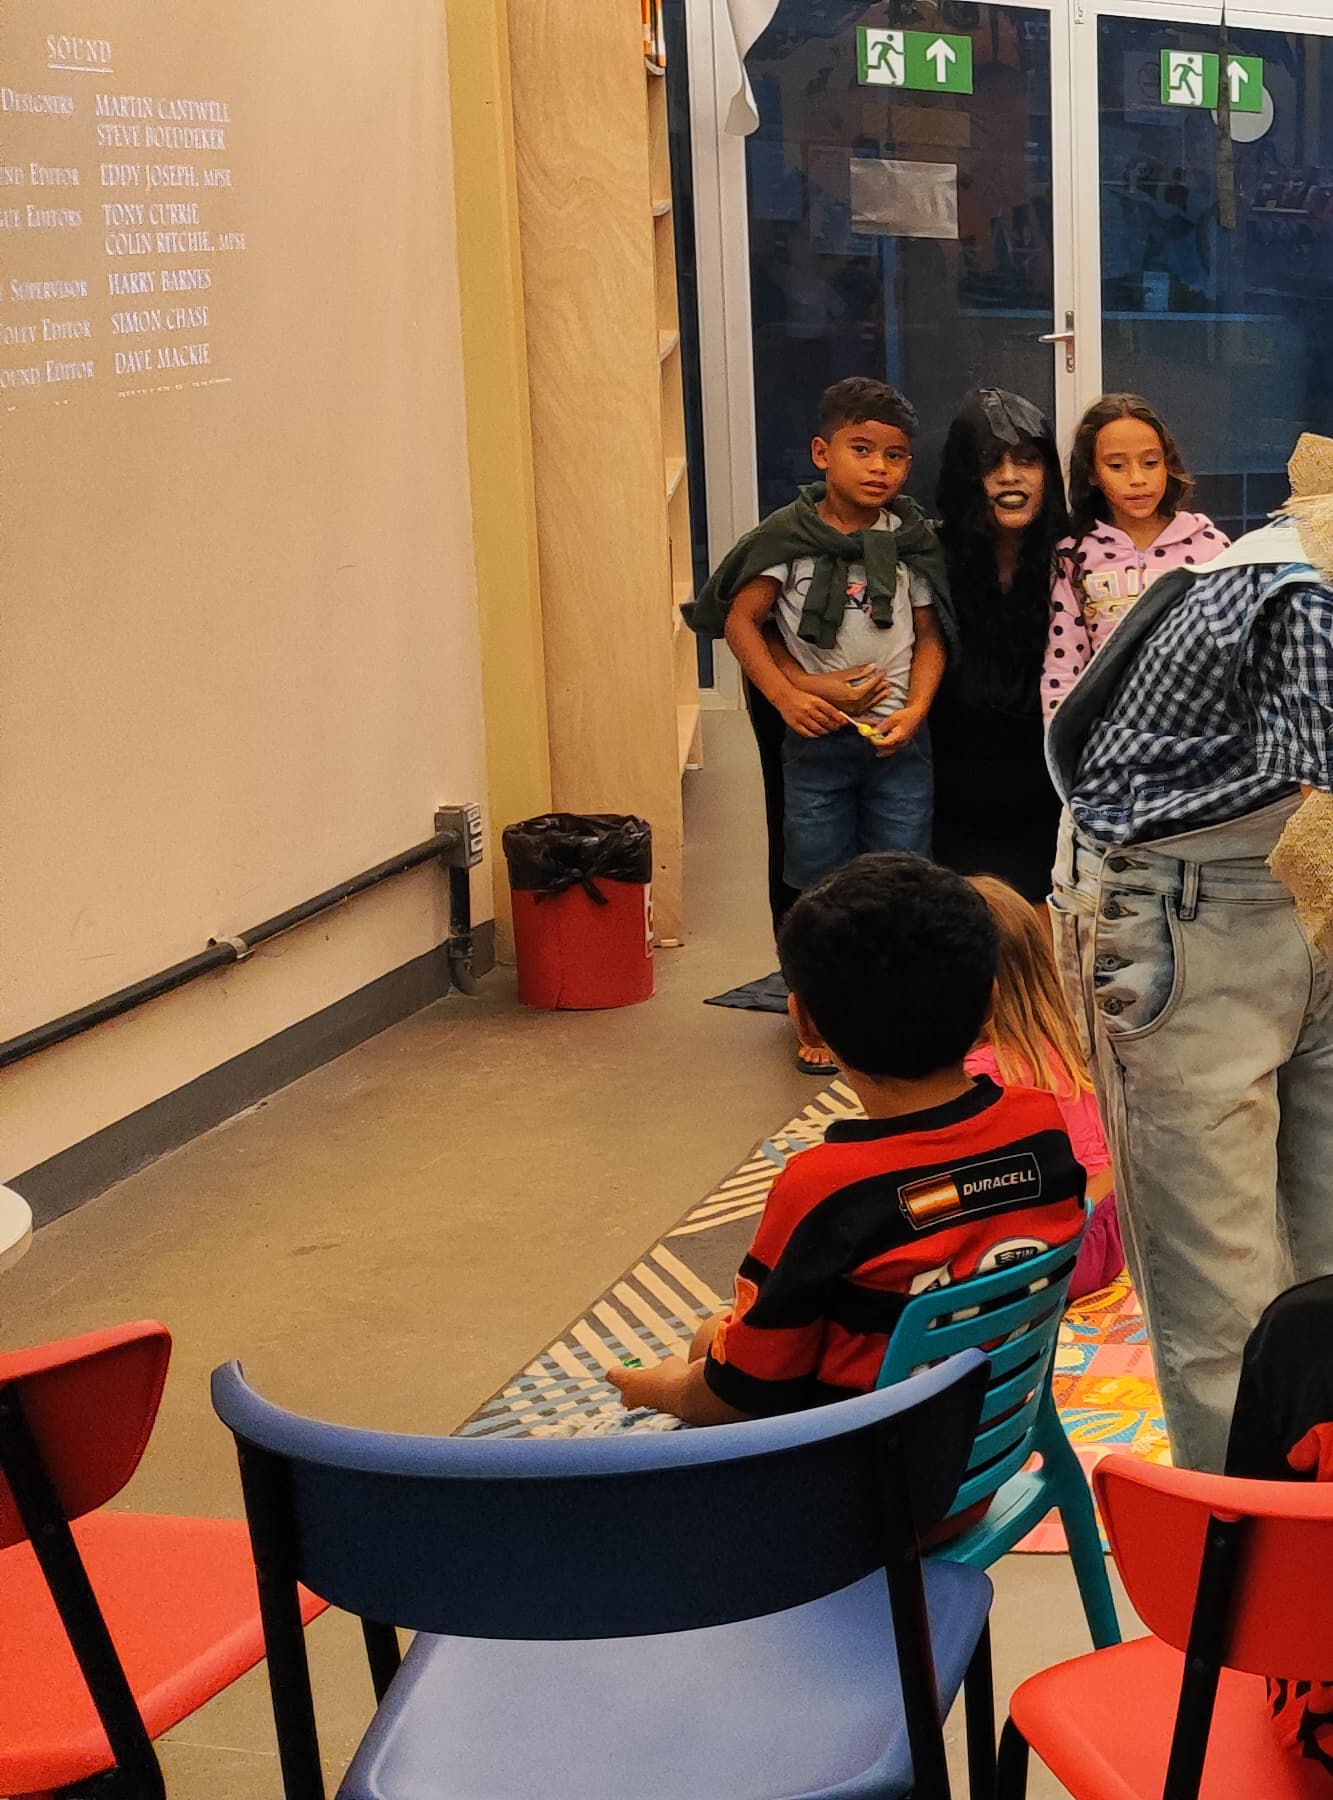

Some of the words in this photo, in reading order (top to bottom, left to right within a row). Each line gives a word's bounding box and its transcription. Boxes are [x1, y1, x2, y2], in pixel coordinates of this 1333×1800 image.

[47, 35, 113, 64] SOUND
[96, 94, 153, 119] MARTIN
[158, 97, 231, 123] CANTWELL
[97, 123, 141, 147] STEVE
[103, 203, 145, 226] TONY
[149, 203, 200, 226] CURRIE
[105, 231, 153, 256] COLIN
[108, 271, 155, 296] HARRY
[161, 268, 212, 292] BARNES
[111, 310, 161, 335] SIMON
[166, 306, 209, 330] CHASE
[114, 349, 153, 375] DAVE
[157, 343, 210, 370] MACKIE
[963, 1169, 1037, 1196] DURACELL
